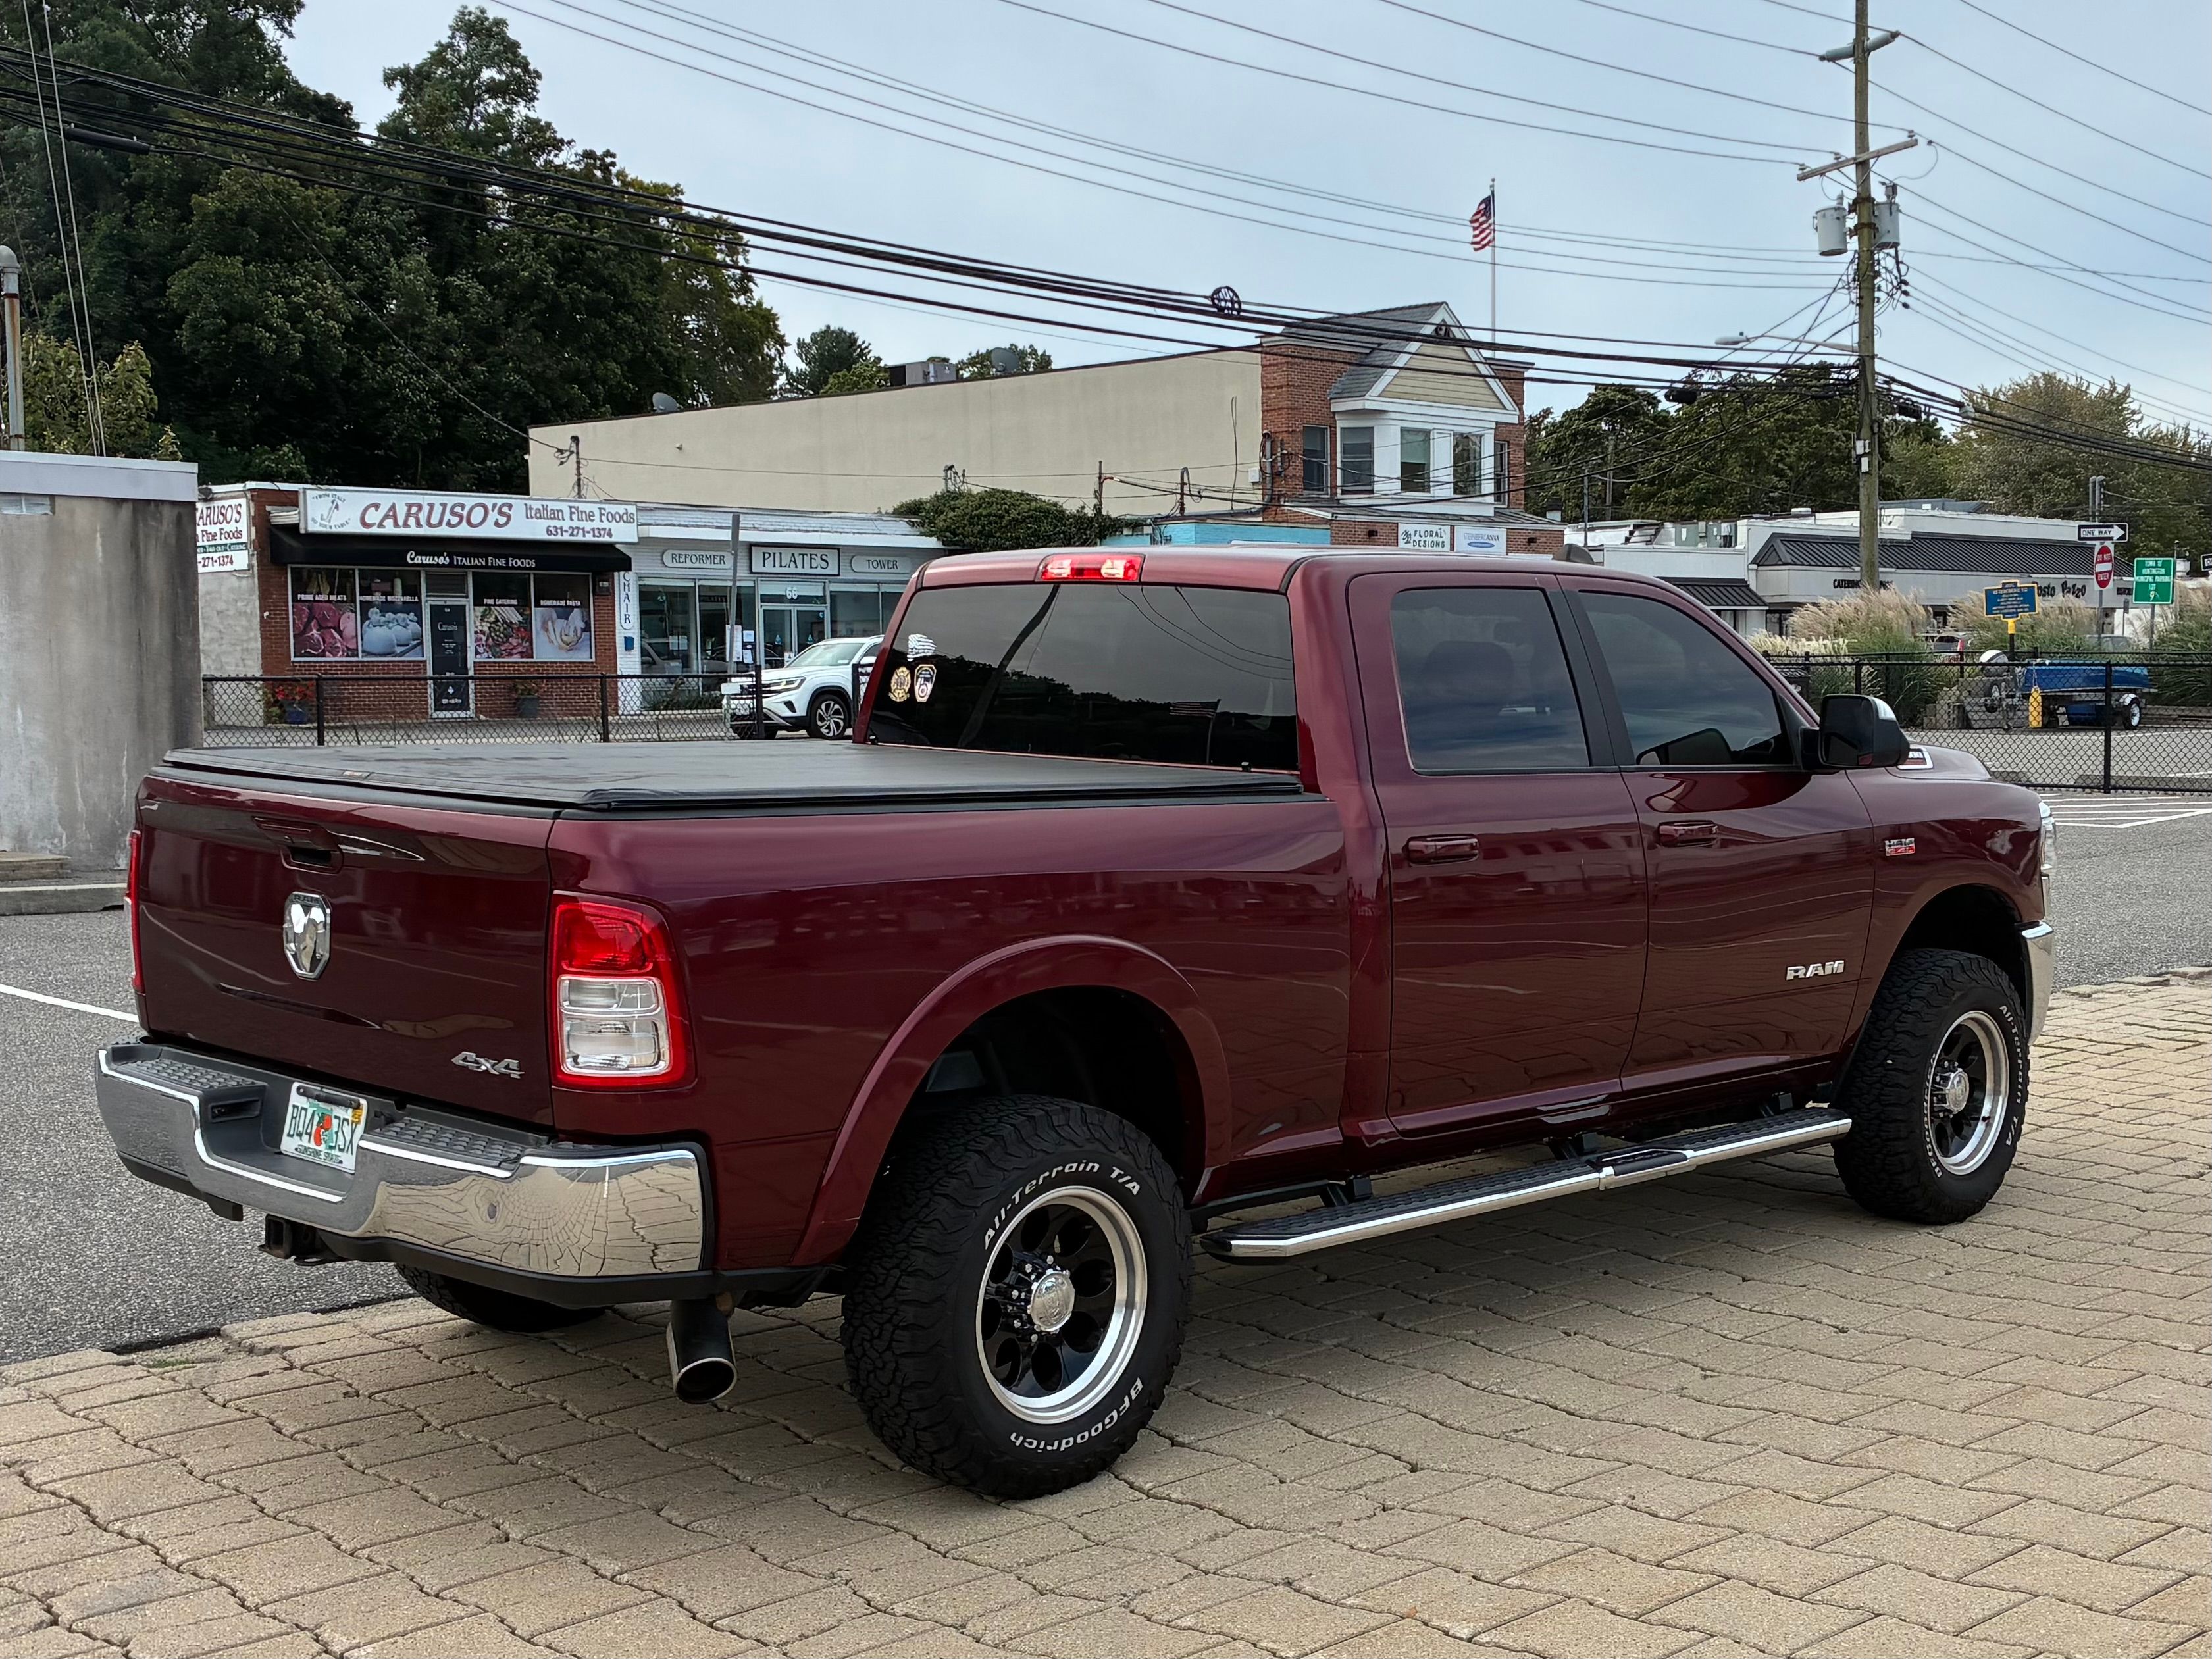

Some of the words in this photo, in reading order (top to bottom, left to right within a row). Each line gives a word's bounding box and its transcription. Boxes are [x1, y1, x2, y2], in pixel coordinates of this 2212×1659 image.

[196, 503, 242, 526] ARUSO'S
[359, 501, 514, 529] CARUSO'S
[524, 503, 565, 521] Italian
[568, 505, 595, 522] Fine
[598, 507, 636, 524] Foods
[201, 530, 217, 542] Fine
[219, 527, 242, 540] Foods
[546, 525, 613, 539] 631-271-1374
[1414, 529, 1443, 538] FLORAL
[1412, 540, 1445, 548] DESIGNS
[407, 550, 450, 565] Caruso's
[453, 556, 486, 566] ITALIAN
[488, 557, 506, 567] FINE
[509, 557, 536, 568] FOODS
[671, 552, 727, 565] REFORMER
[762, 551, 829, 570] PILATES
[865, 558, 899, 571] TOWER
[623, 571, 631, 623] CHAIR
[1786, 960, 1845, 981] RAM
[985, 1160, 1100, 1250] All-Terrain
[1110, 1166, 1141, 1196] T/A
[1010, 1377, 1144, 1453] BFGoodrich
